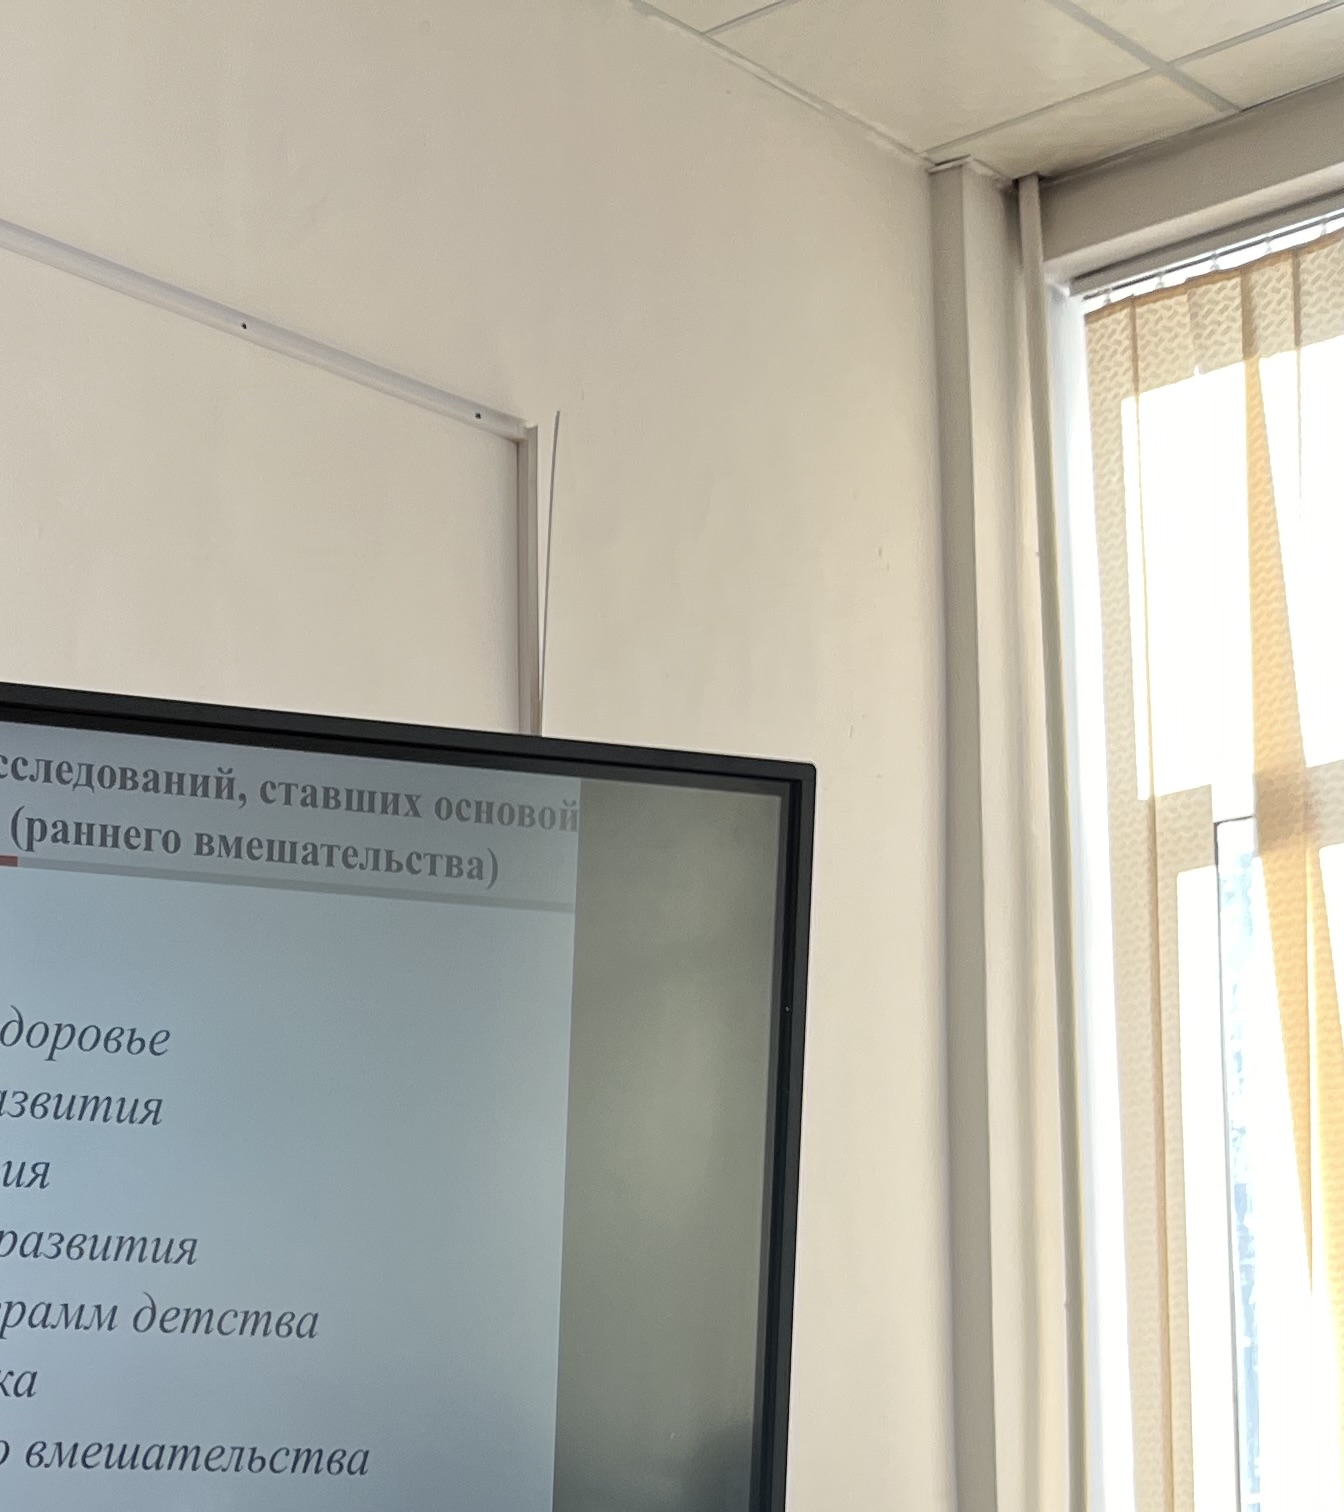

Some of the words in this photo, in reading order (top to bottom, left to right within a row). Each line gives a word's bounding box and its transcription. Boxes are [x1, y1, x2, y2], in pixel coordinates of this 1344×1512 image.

[259, 779, 423, 819] ставших
[433, 796, 580, 833] основой
[9, 804, 183, 856] (раннего
[191, 831, 500, 891] вмешательства)
[133, 1292, 319, 1339] детства
[25, 1441, 370, 1476] вмешательства
